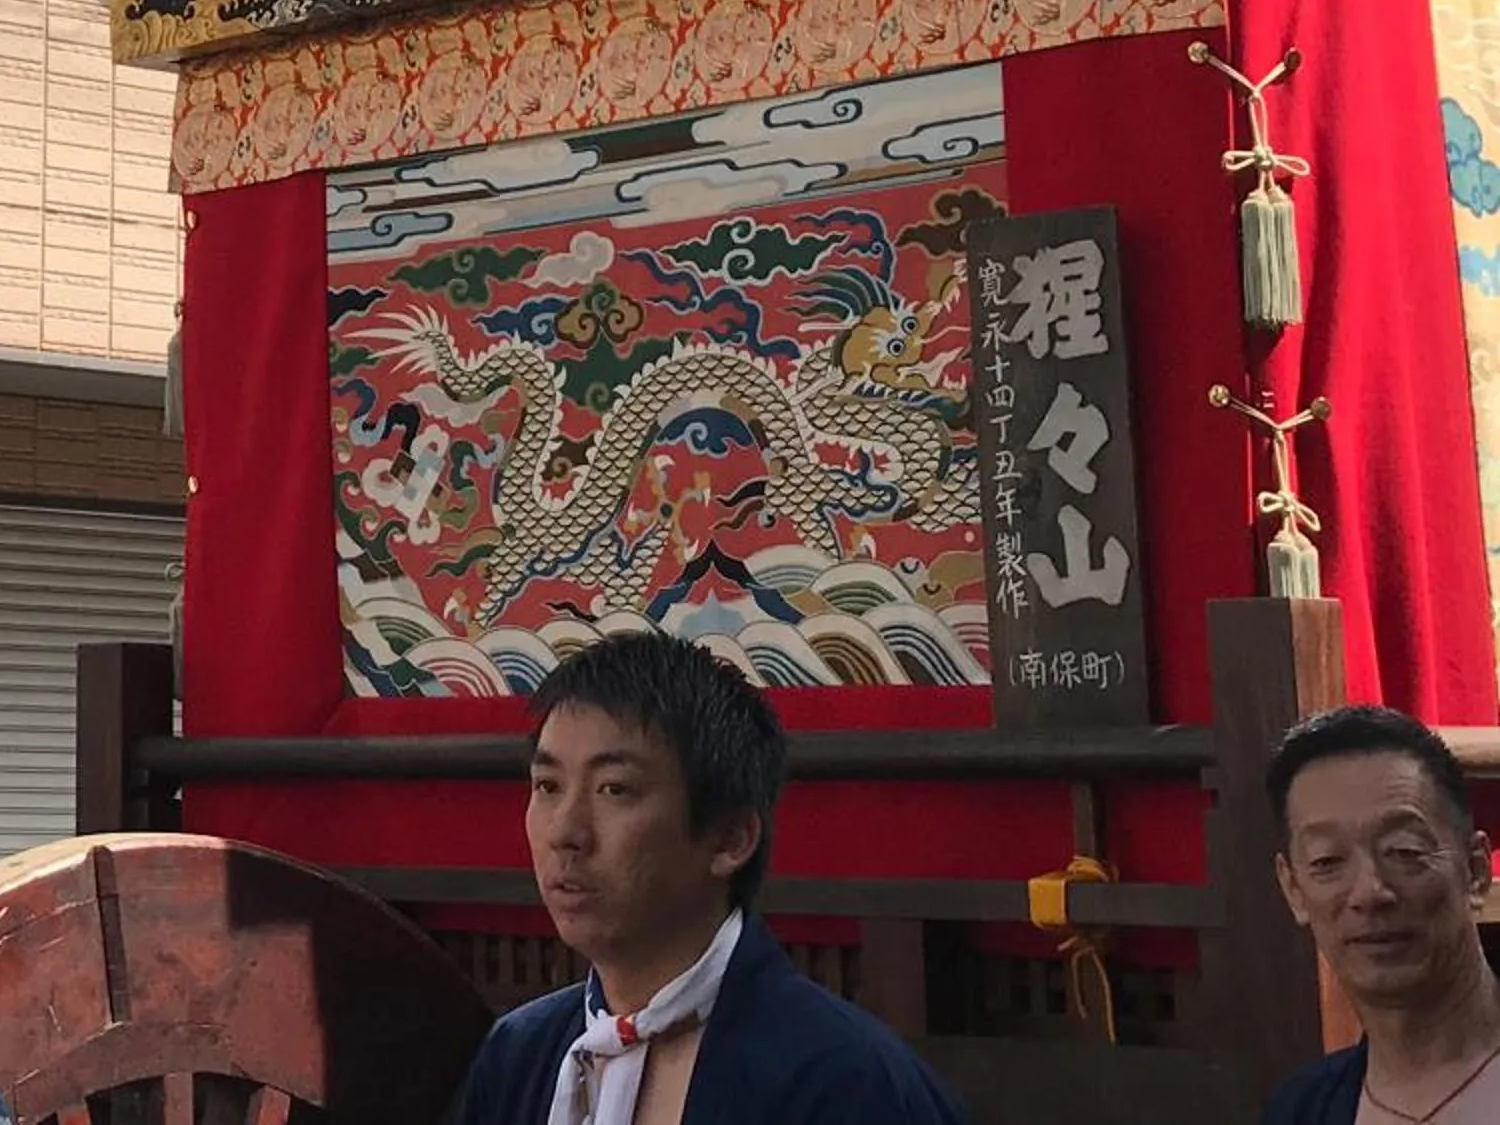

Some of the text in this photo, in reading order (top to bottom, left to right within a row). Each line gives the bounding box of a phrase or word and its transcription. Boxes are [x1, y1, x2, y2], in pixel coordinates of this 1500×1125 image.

[1006, 238, 1132, 608] 猩々山
[1008, 649, 1126, 690] (南保町)
